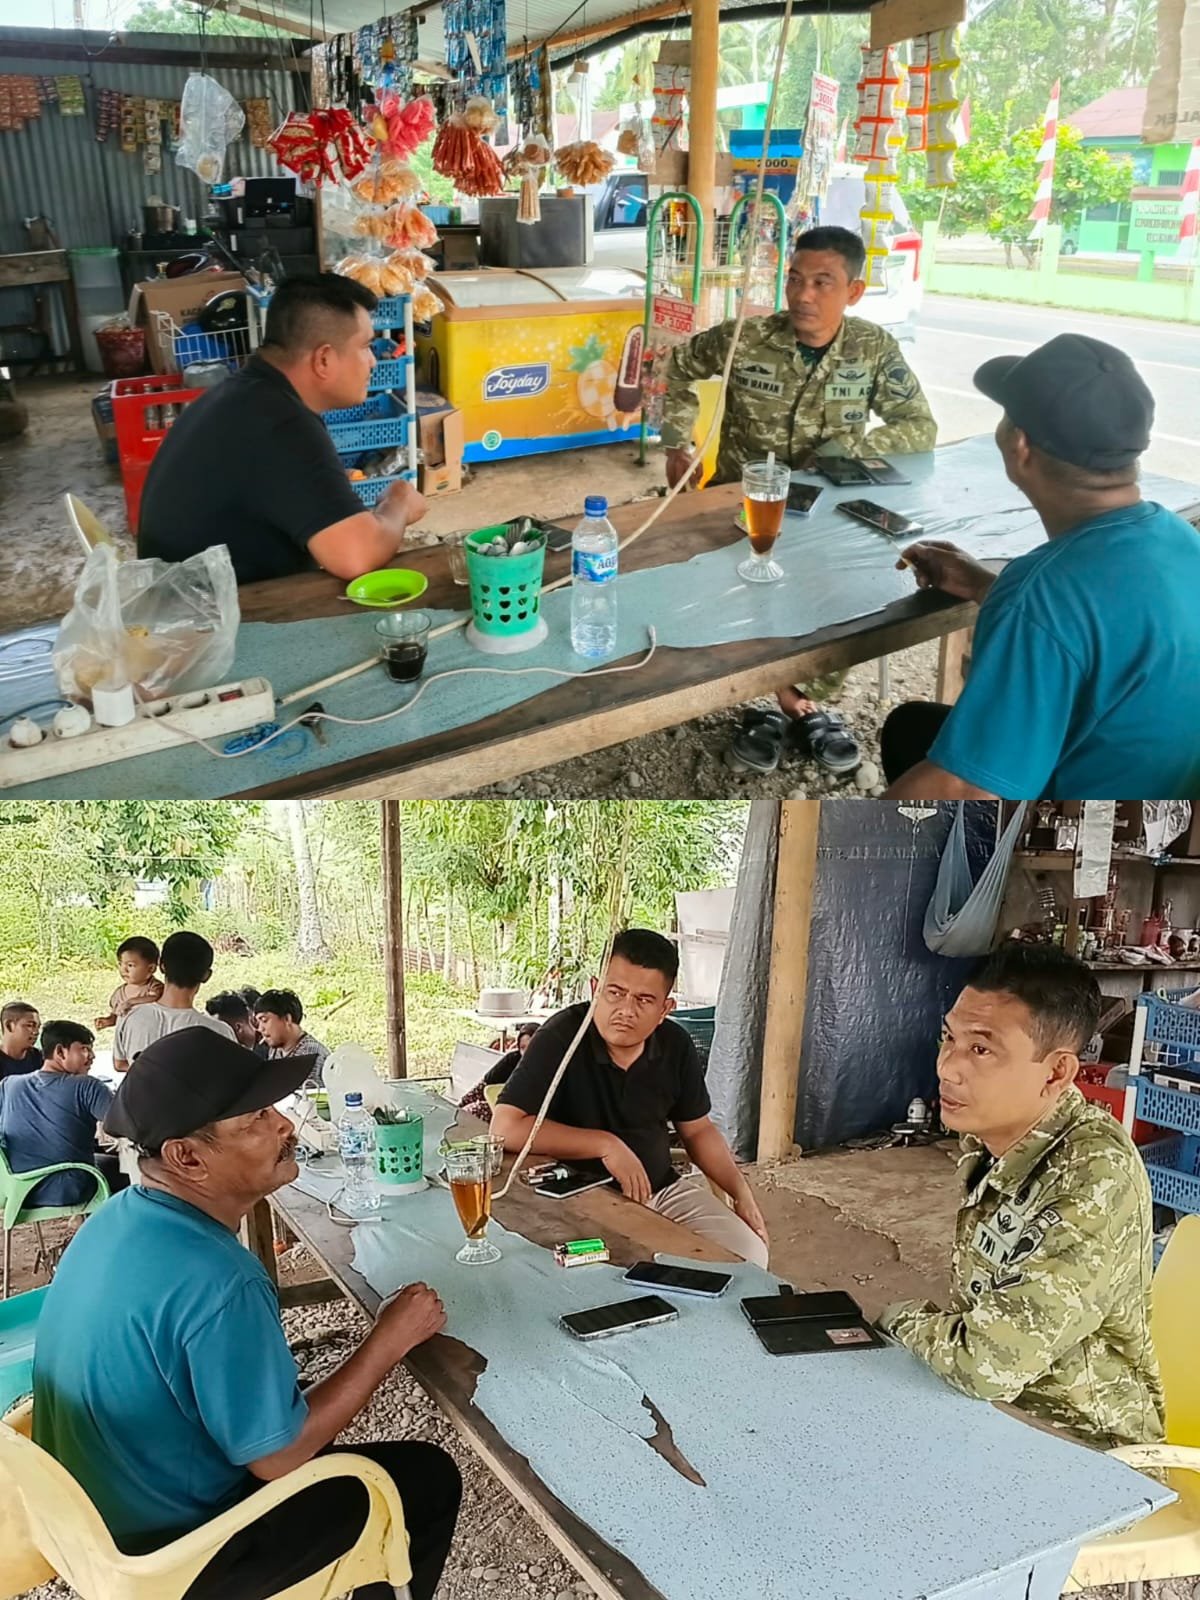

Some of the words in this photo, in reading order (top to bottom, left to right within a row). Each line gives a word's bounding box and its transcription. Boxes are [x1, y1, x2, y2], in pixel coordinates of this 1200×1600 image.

[487, 372, 544, 394] Joyday
[750, 378, 780, 394] IRAWAN
[832, 387, 851, 397] TNI
[978, 1230, 996, 1257] TNI
